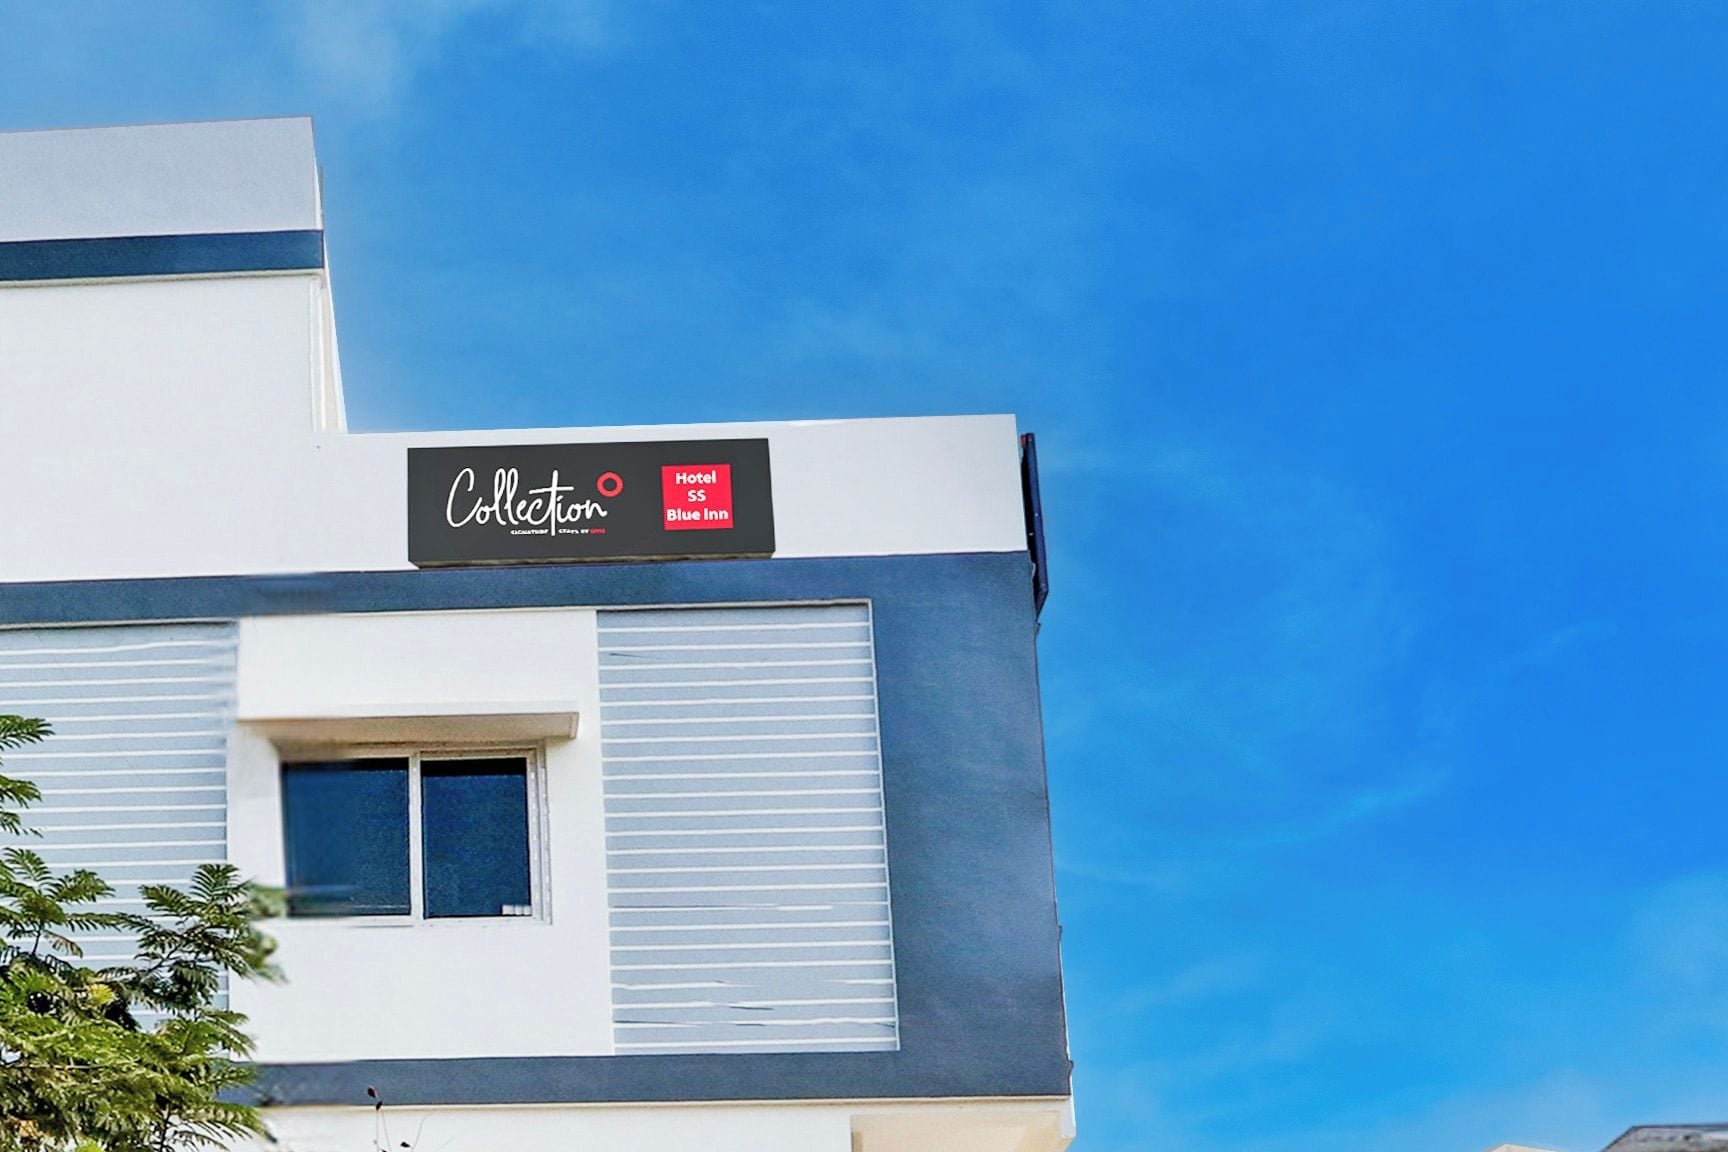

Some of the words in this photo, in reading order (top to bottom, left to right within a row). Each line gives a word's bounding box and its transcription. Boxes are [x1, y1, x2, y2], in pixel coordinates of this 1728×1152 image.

[675, 470, 717, 485] Hotel
[446, 467, 608, 536] Collection
[687, 489, 707, 502] SS
[666, 508, 701, 522] Blue
[703, 507, 729, 520] Inn
